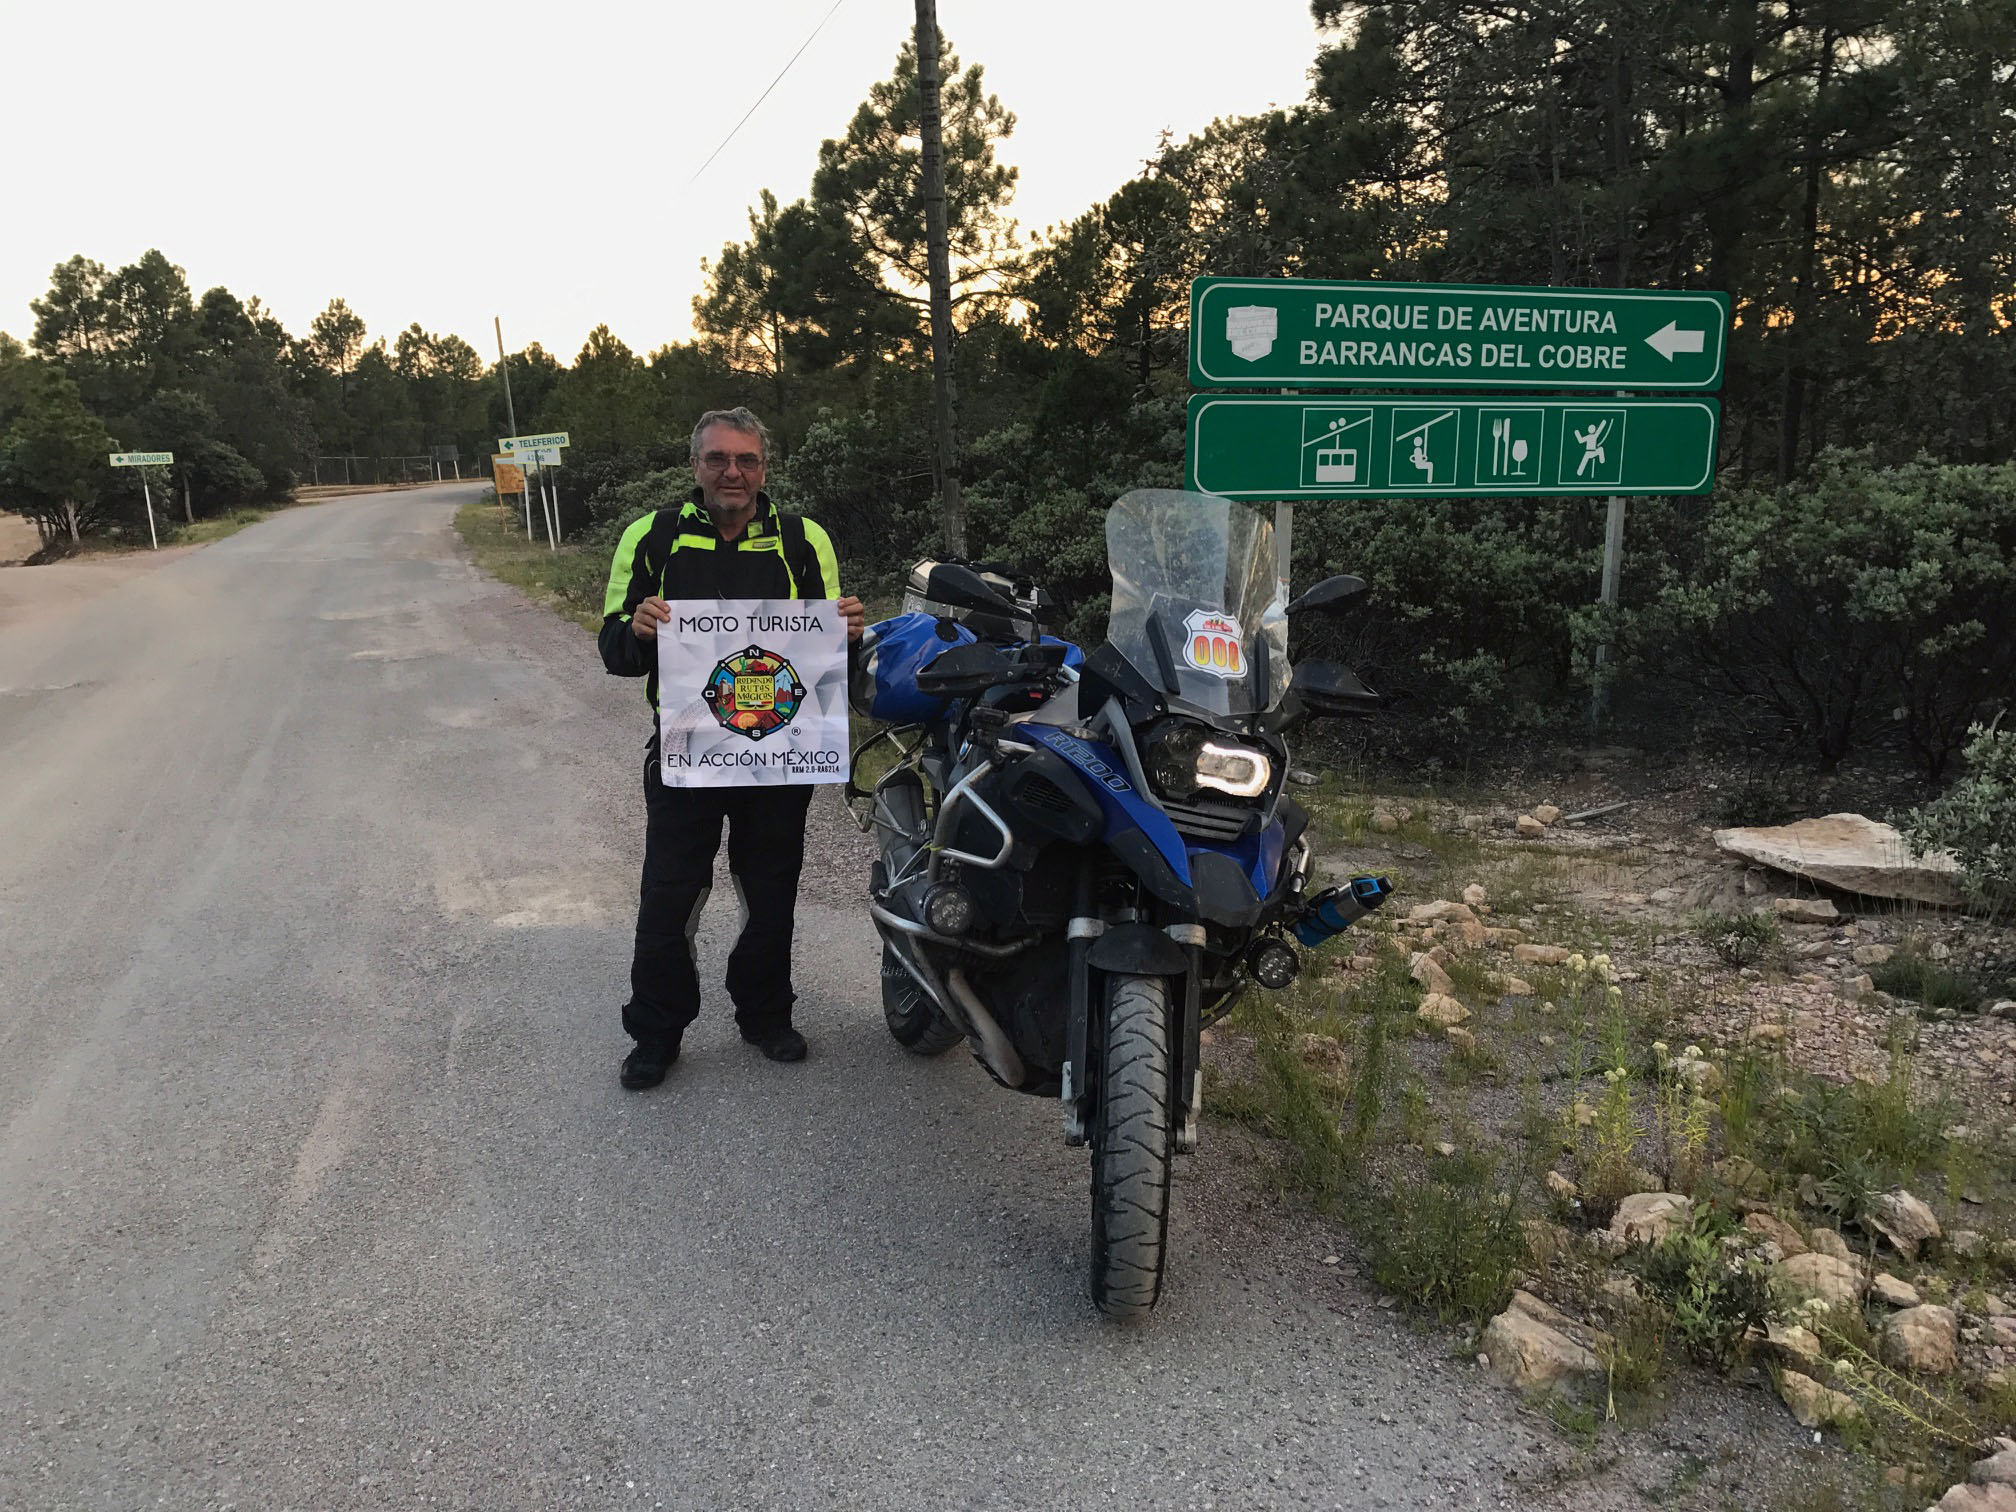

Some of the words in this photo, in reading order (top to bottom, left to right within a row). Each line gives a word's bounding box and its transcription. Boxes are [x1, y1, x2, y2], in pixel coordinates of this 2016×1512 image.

[1314, 303, 1429, 331] PARQUE
[1437, 306, 1473, 331] DE
[1479, 307, 1618, 335] AVENTURA
[1299, 340, 1473, 368] BARRANCAS
[1480, 343, 1531, 368] DEL
[1537, 345, 1627, 370] COBRE
[519, 436, 566, 448] TELEFERICO
[127, 454, 171, 463] MIRADORES
[679, 616, 739, 633] MOTO
[747, 616, 824, 633] TURISTA
[749, 649, 760, 657] N
[667, 753, 692, 768] EN
[698, 749, 767, 767] ACCIÓN
[772, 748, 840, 766] MÉXICO
[1043, 731, 1132, 792] R1200
